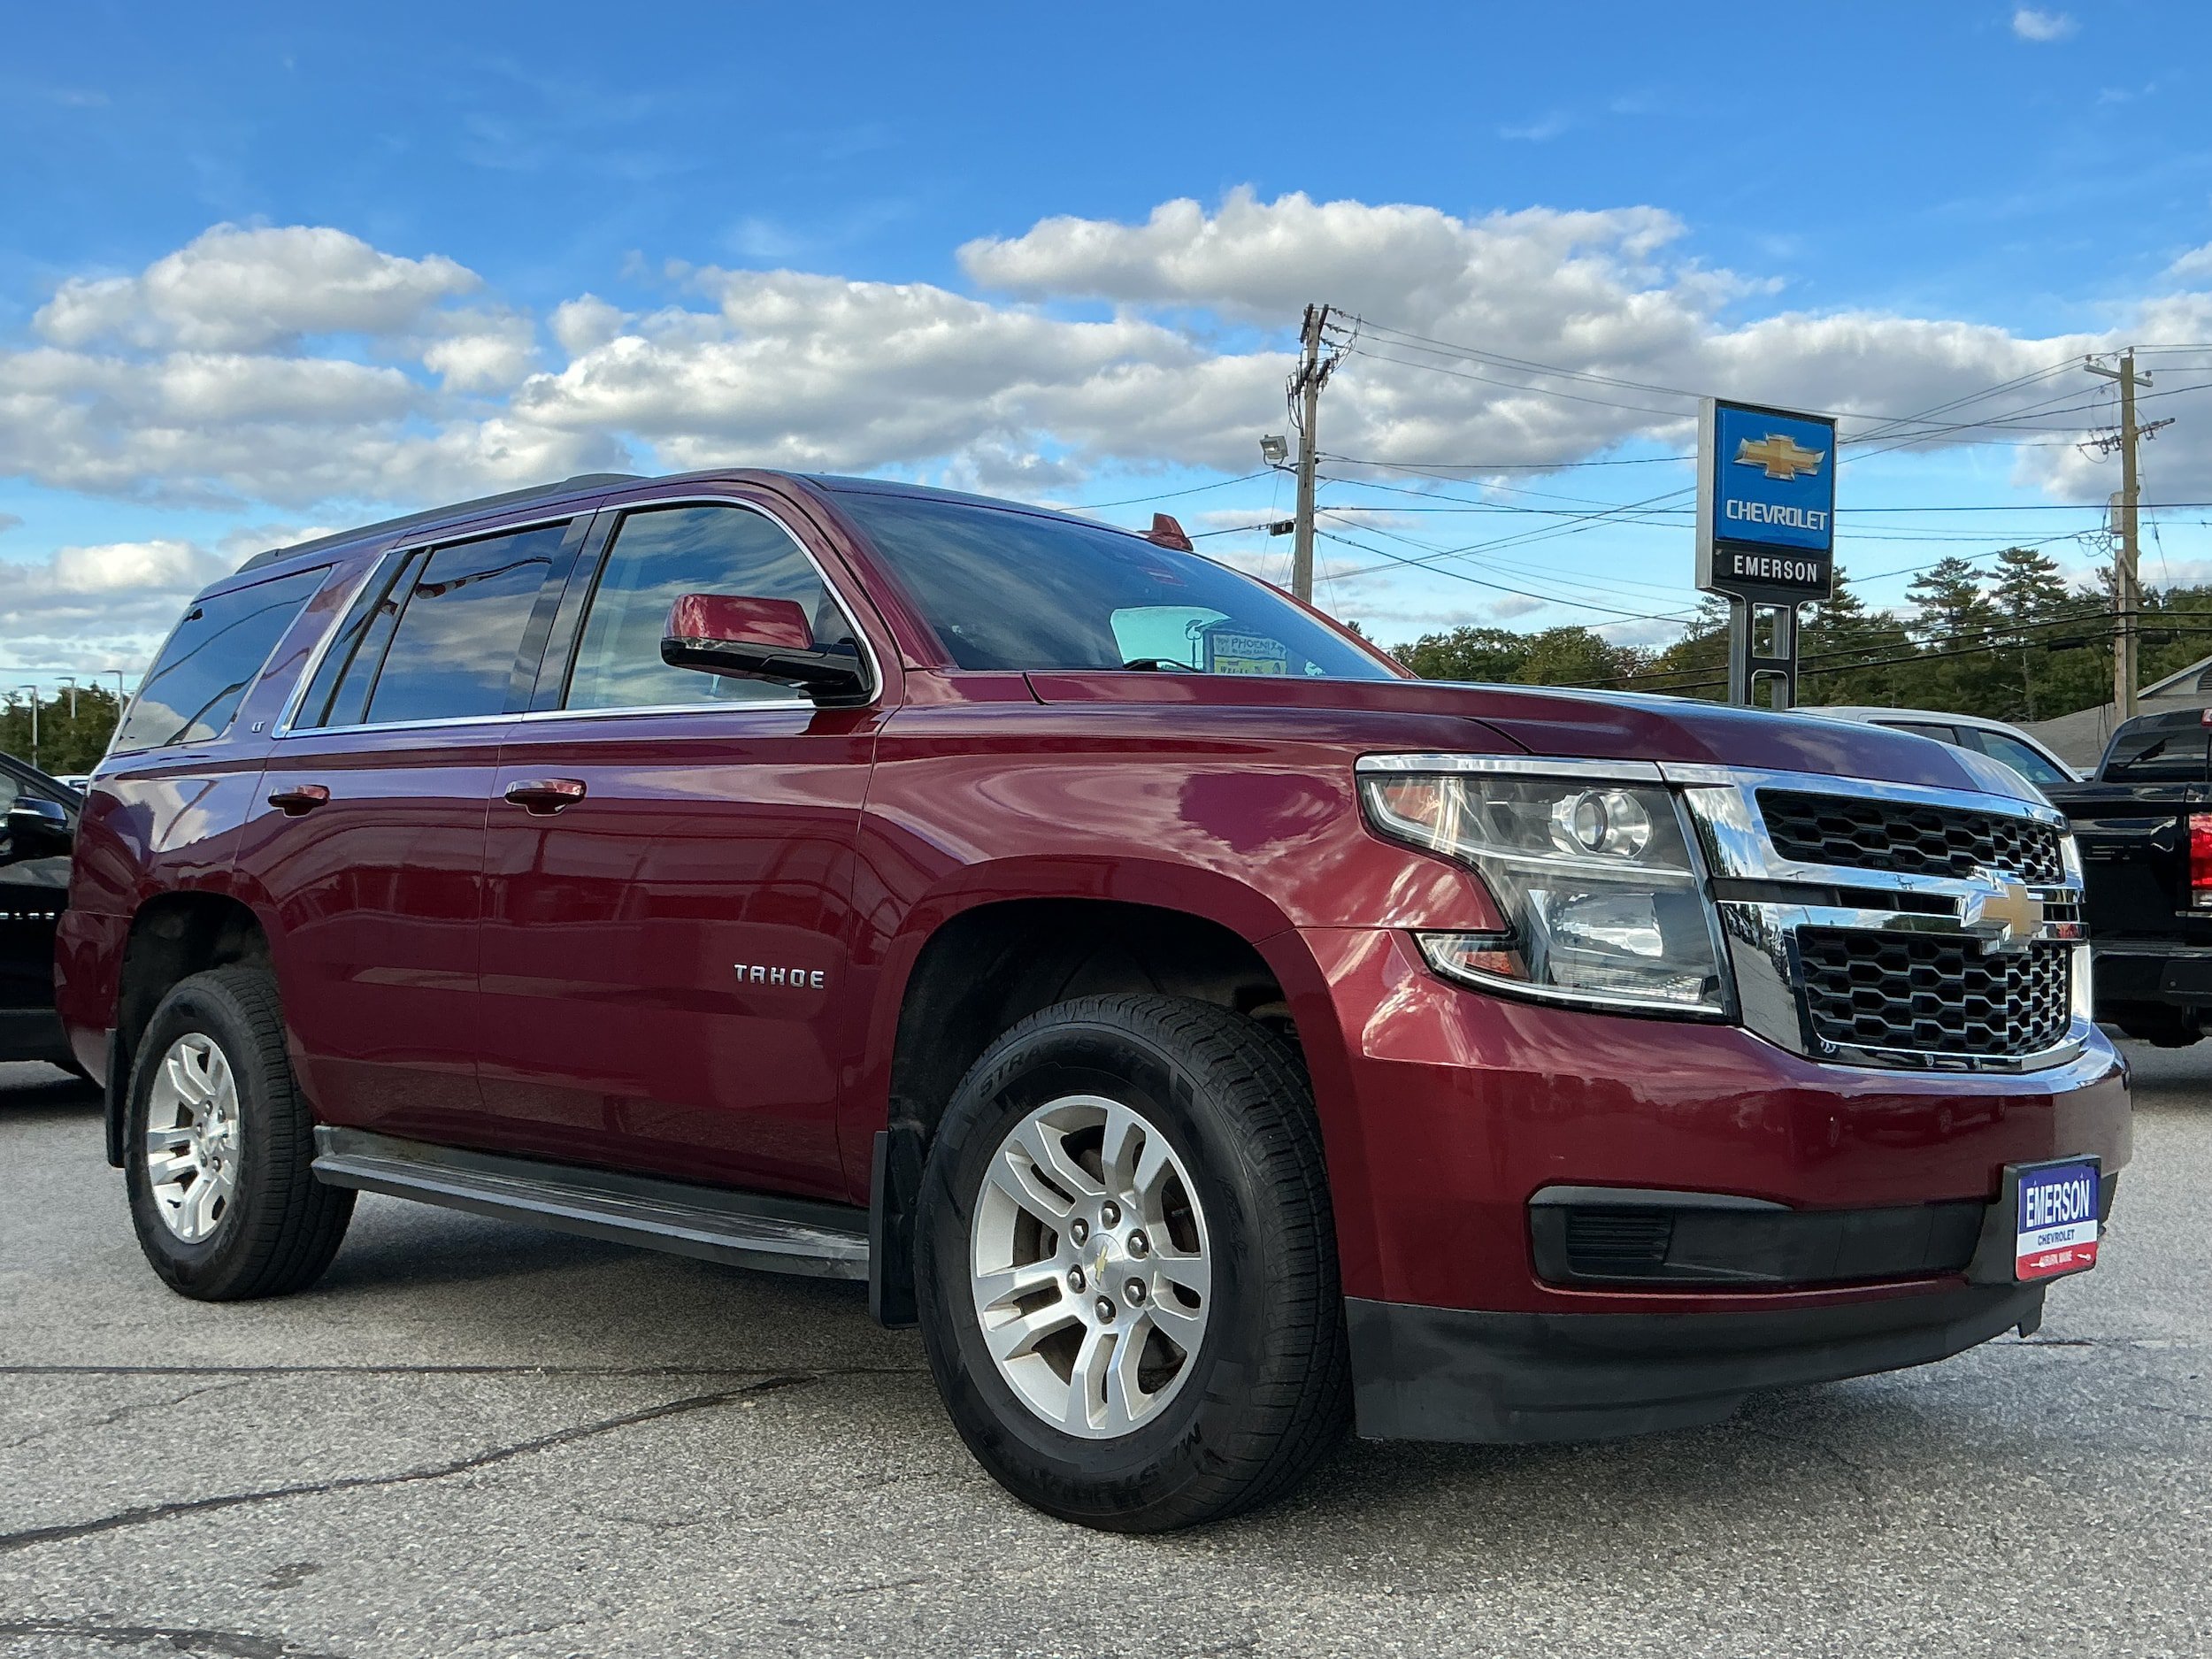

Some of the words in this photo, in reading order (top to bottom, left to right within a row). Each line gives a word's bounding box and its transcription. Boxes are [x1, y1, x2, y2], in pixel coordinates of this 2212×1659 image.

[1726, 499, 1828, 531] CHEVROLET
[1733, 555, 1818, 583] EMERSON
[733, 964, 825, 989] TAHOE
[2025, 1179, 2091, 1228] EMERSON
[2038, 1229, 2076, 1247] CHEVROLET
